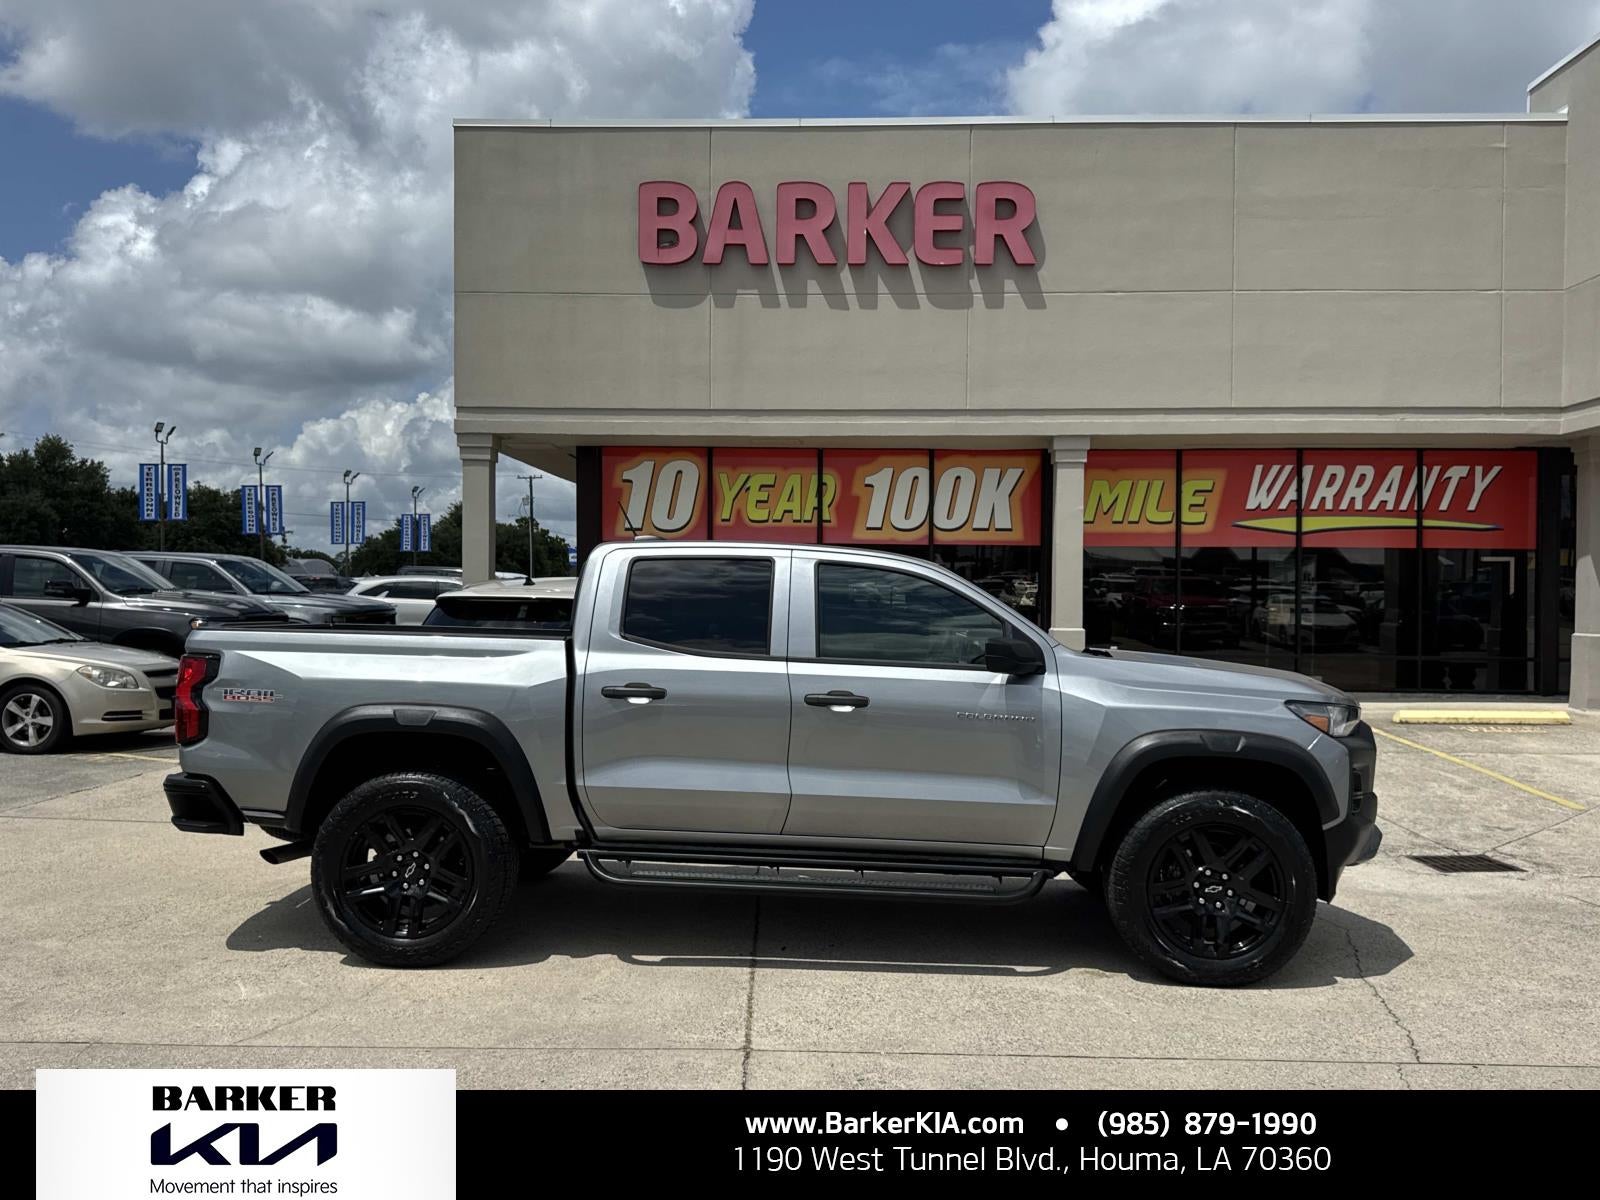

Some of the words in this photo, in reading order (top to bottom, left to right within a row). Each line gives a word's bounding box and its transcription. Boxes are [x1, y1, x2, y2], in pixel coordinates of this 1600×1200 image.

[638, 180, 1037, 266] BARKER
[621, 460, 700, 532] 10
[719, 472, 838, 524] YEAR
[864, 466, 1025, 532] 100K
[1084, 479, 1215, 525] MILE
[1245, 464, 1502, 512] WARRANTY
